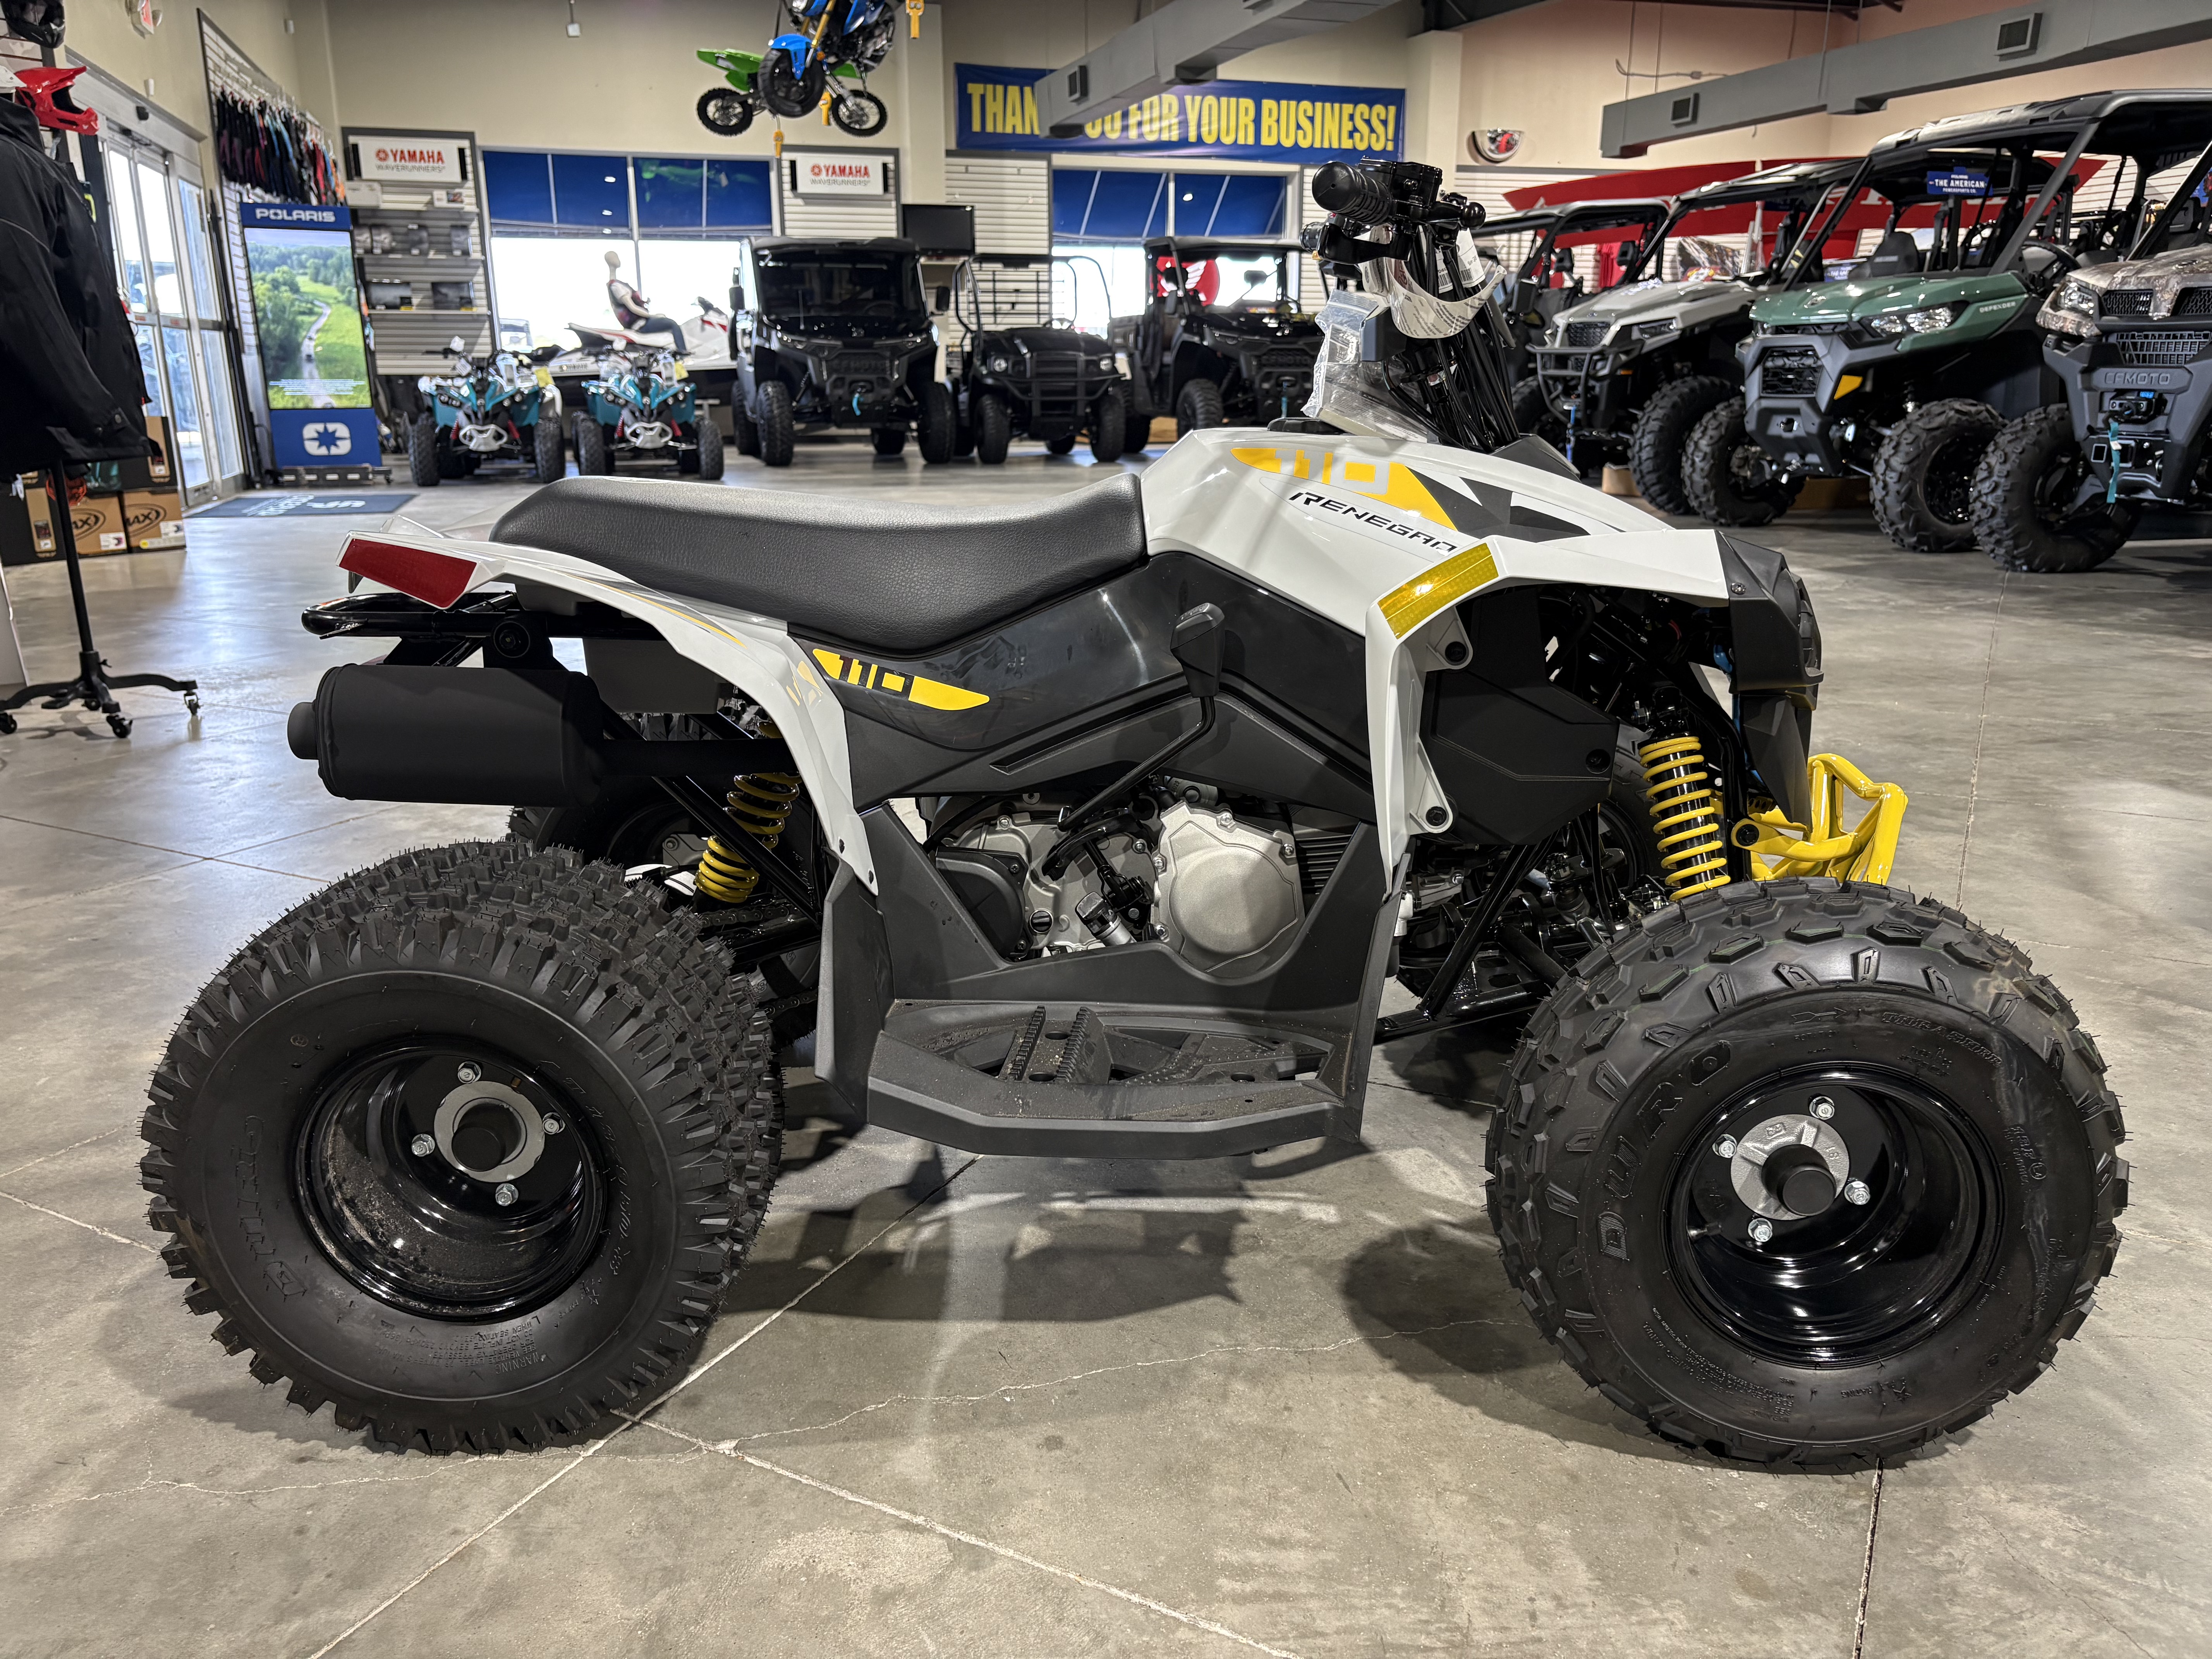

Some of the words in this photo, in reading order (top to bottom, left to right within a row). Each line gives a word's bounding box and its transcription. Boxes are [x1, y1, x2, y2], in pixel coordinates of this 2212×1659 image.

[967, 82, 1040, 135] THAN
[1128, 93, 1180, 142] FOR
[1184, 95, 1255, 146] YOUR
[1261, 99, 1398, 151] BUSINESS!
[390, 148, 445, 164] YAMAHA
[823, 164, 871, 178] YAMAHA
[1950, 179, 1985, 188] AMERICAN
[255, 208, 336, 223] POLARIS
[1979, 301, 2016, 313] DEFENDER
[2104, 372, 2171, 385] CFMOTO
[1275, 449, 1389, 495] 110
[1288, 491, 1458, 556] RENEGAD
[838, 654, 915, 701] 110
[1597, 1039, 1731, 1262] DURO
[512, 1321, 532, 1334] WHEN
[473, 1338, 503, 1350] INFLATE
[506, 1333, 520, 1344] NOT
[488, 1351, 519, 1364] VEHICLE
[496, 1352, 540, 1374] WARNING
[1841, 1386, 1872, 1398] RATING
